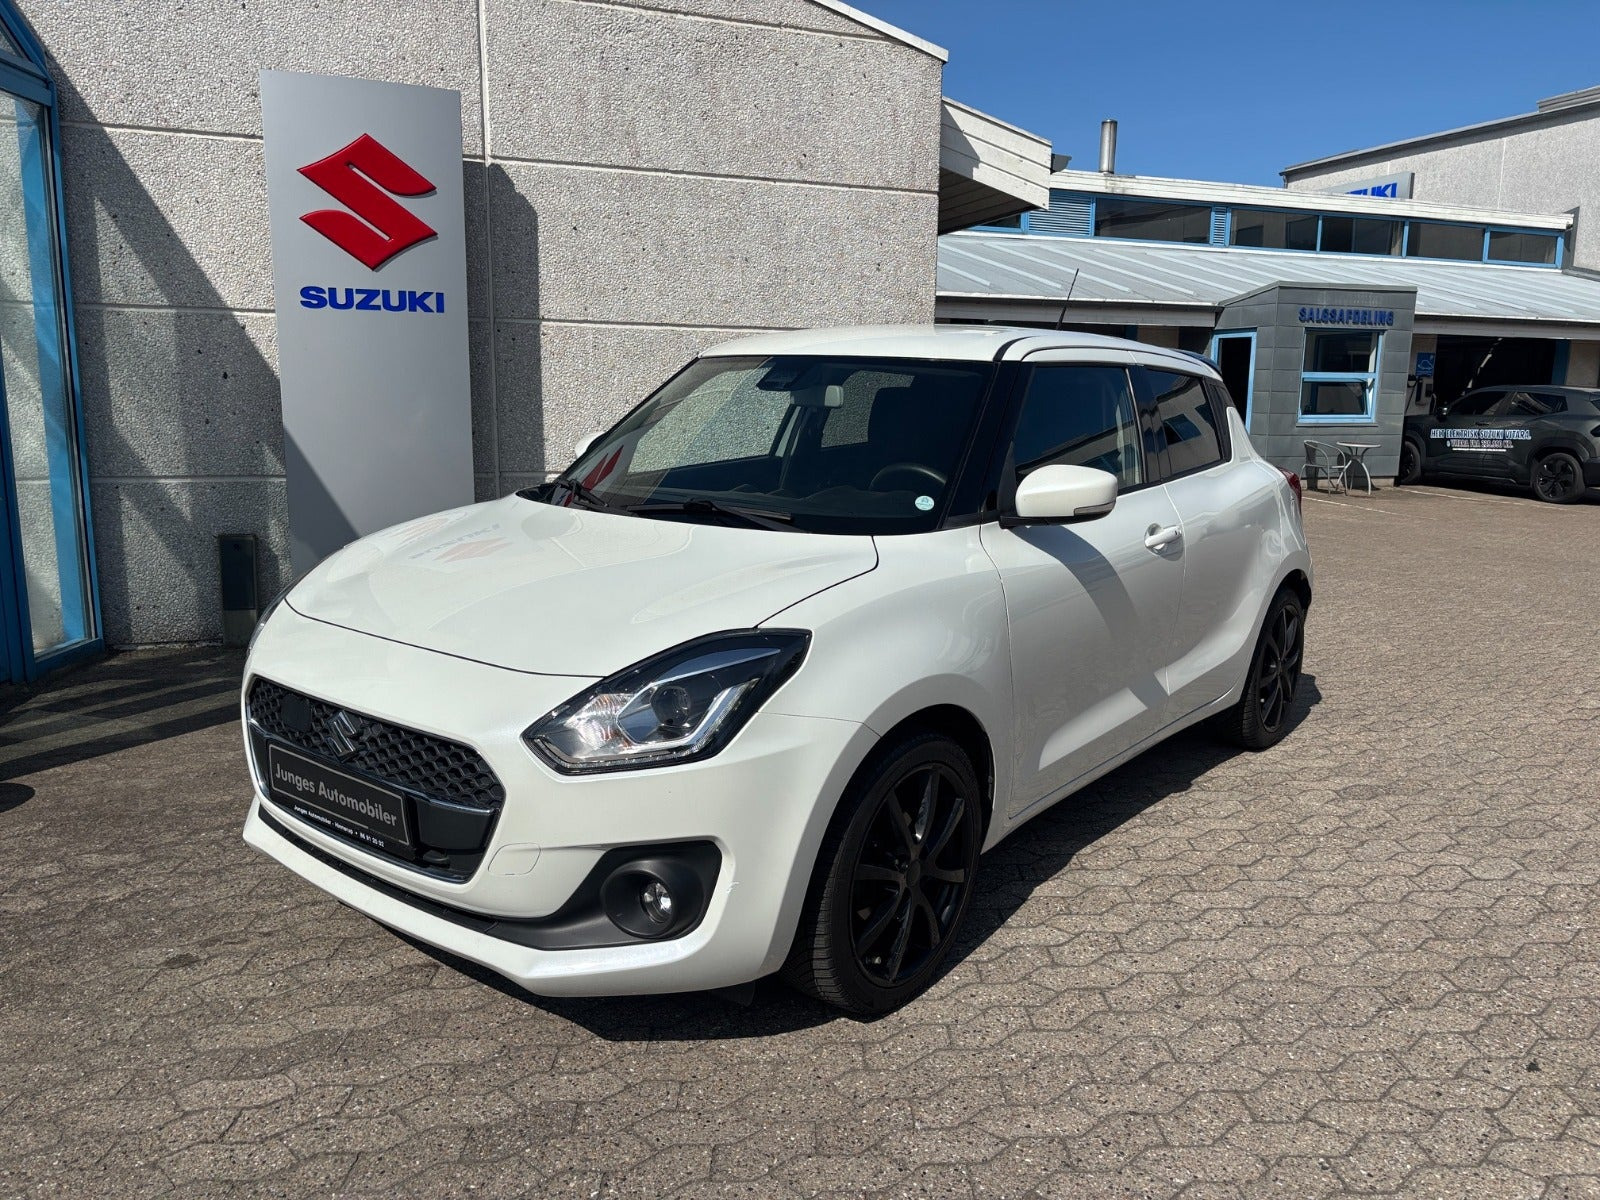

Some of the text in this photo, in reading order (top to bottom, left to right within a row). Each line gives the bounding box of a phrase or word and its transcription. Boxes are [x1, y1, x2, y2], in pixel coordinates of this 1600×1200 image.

[299, 285, 445, 313] SUZUKI
[1298, 307, 1394, 326] SALGSAFDELING
[275, 763, 397, 826] Junges Automobiler
